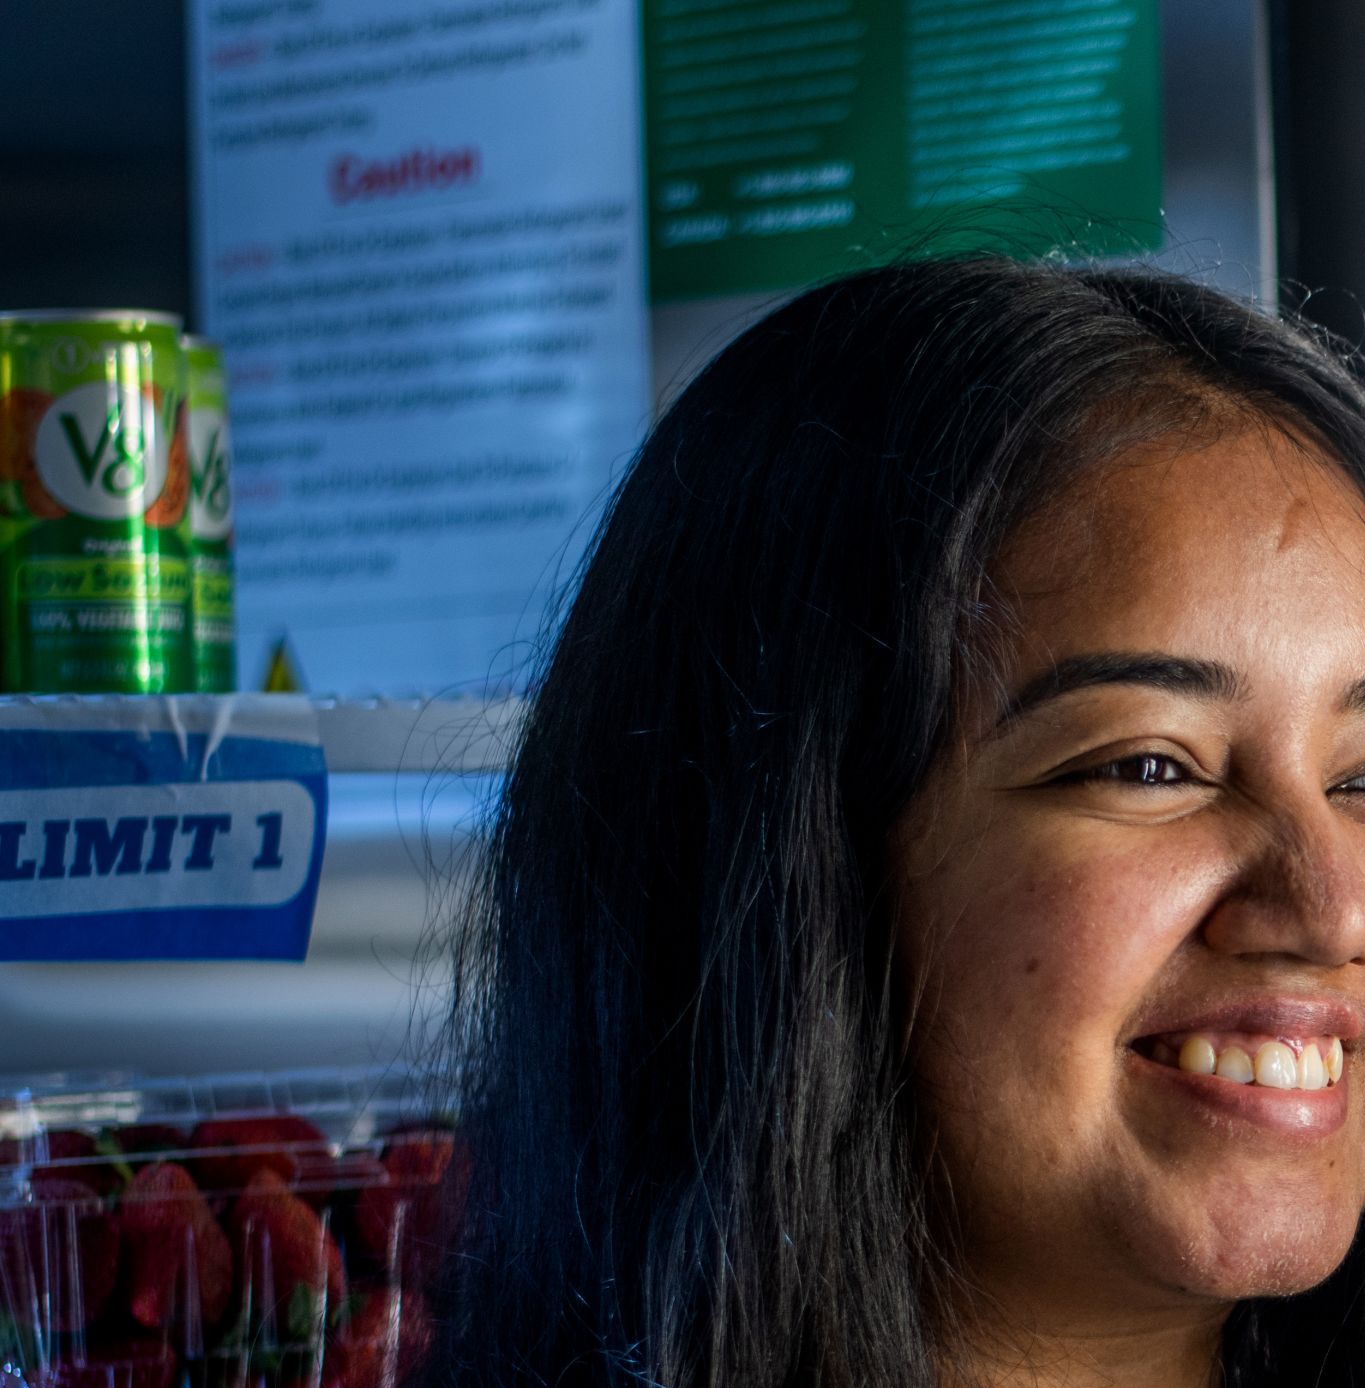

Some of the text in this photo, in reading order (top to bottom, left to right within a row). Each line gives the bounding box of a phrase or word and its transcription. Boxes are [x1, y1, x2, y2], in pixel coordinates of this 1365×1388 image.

[58, 402, 146, 496] V8
[0, 812, 283, 881] LIMIT 1
